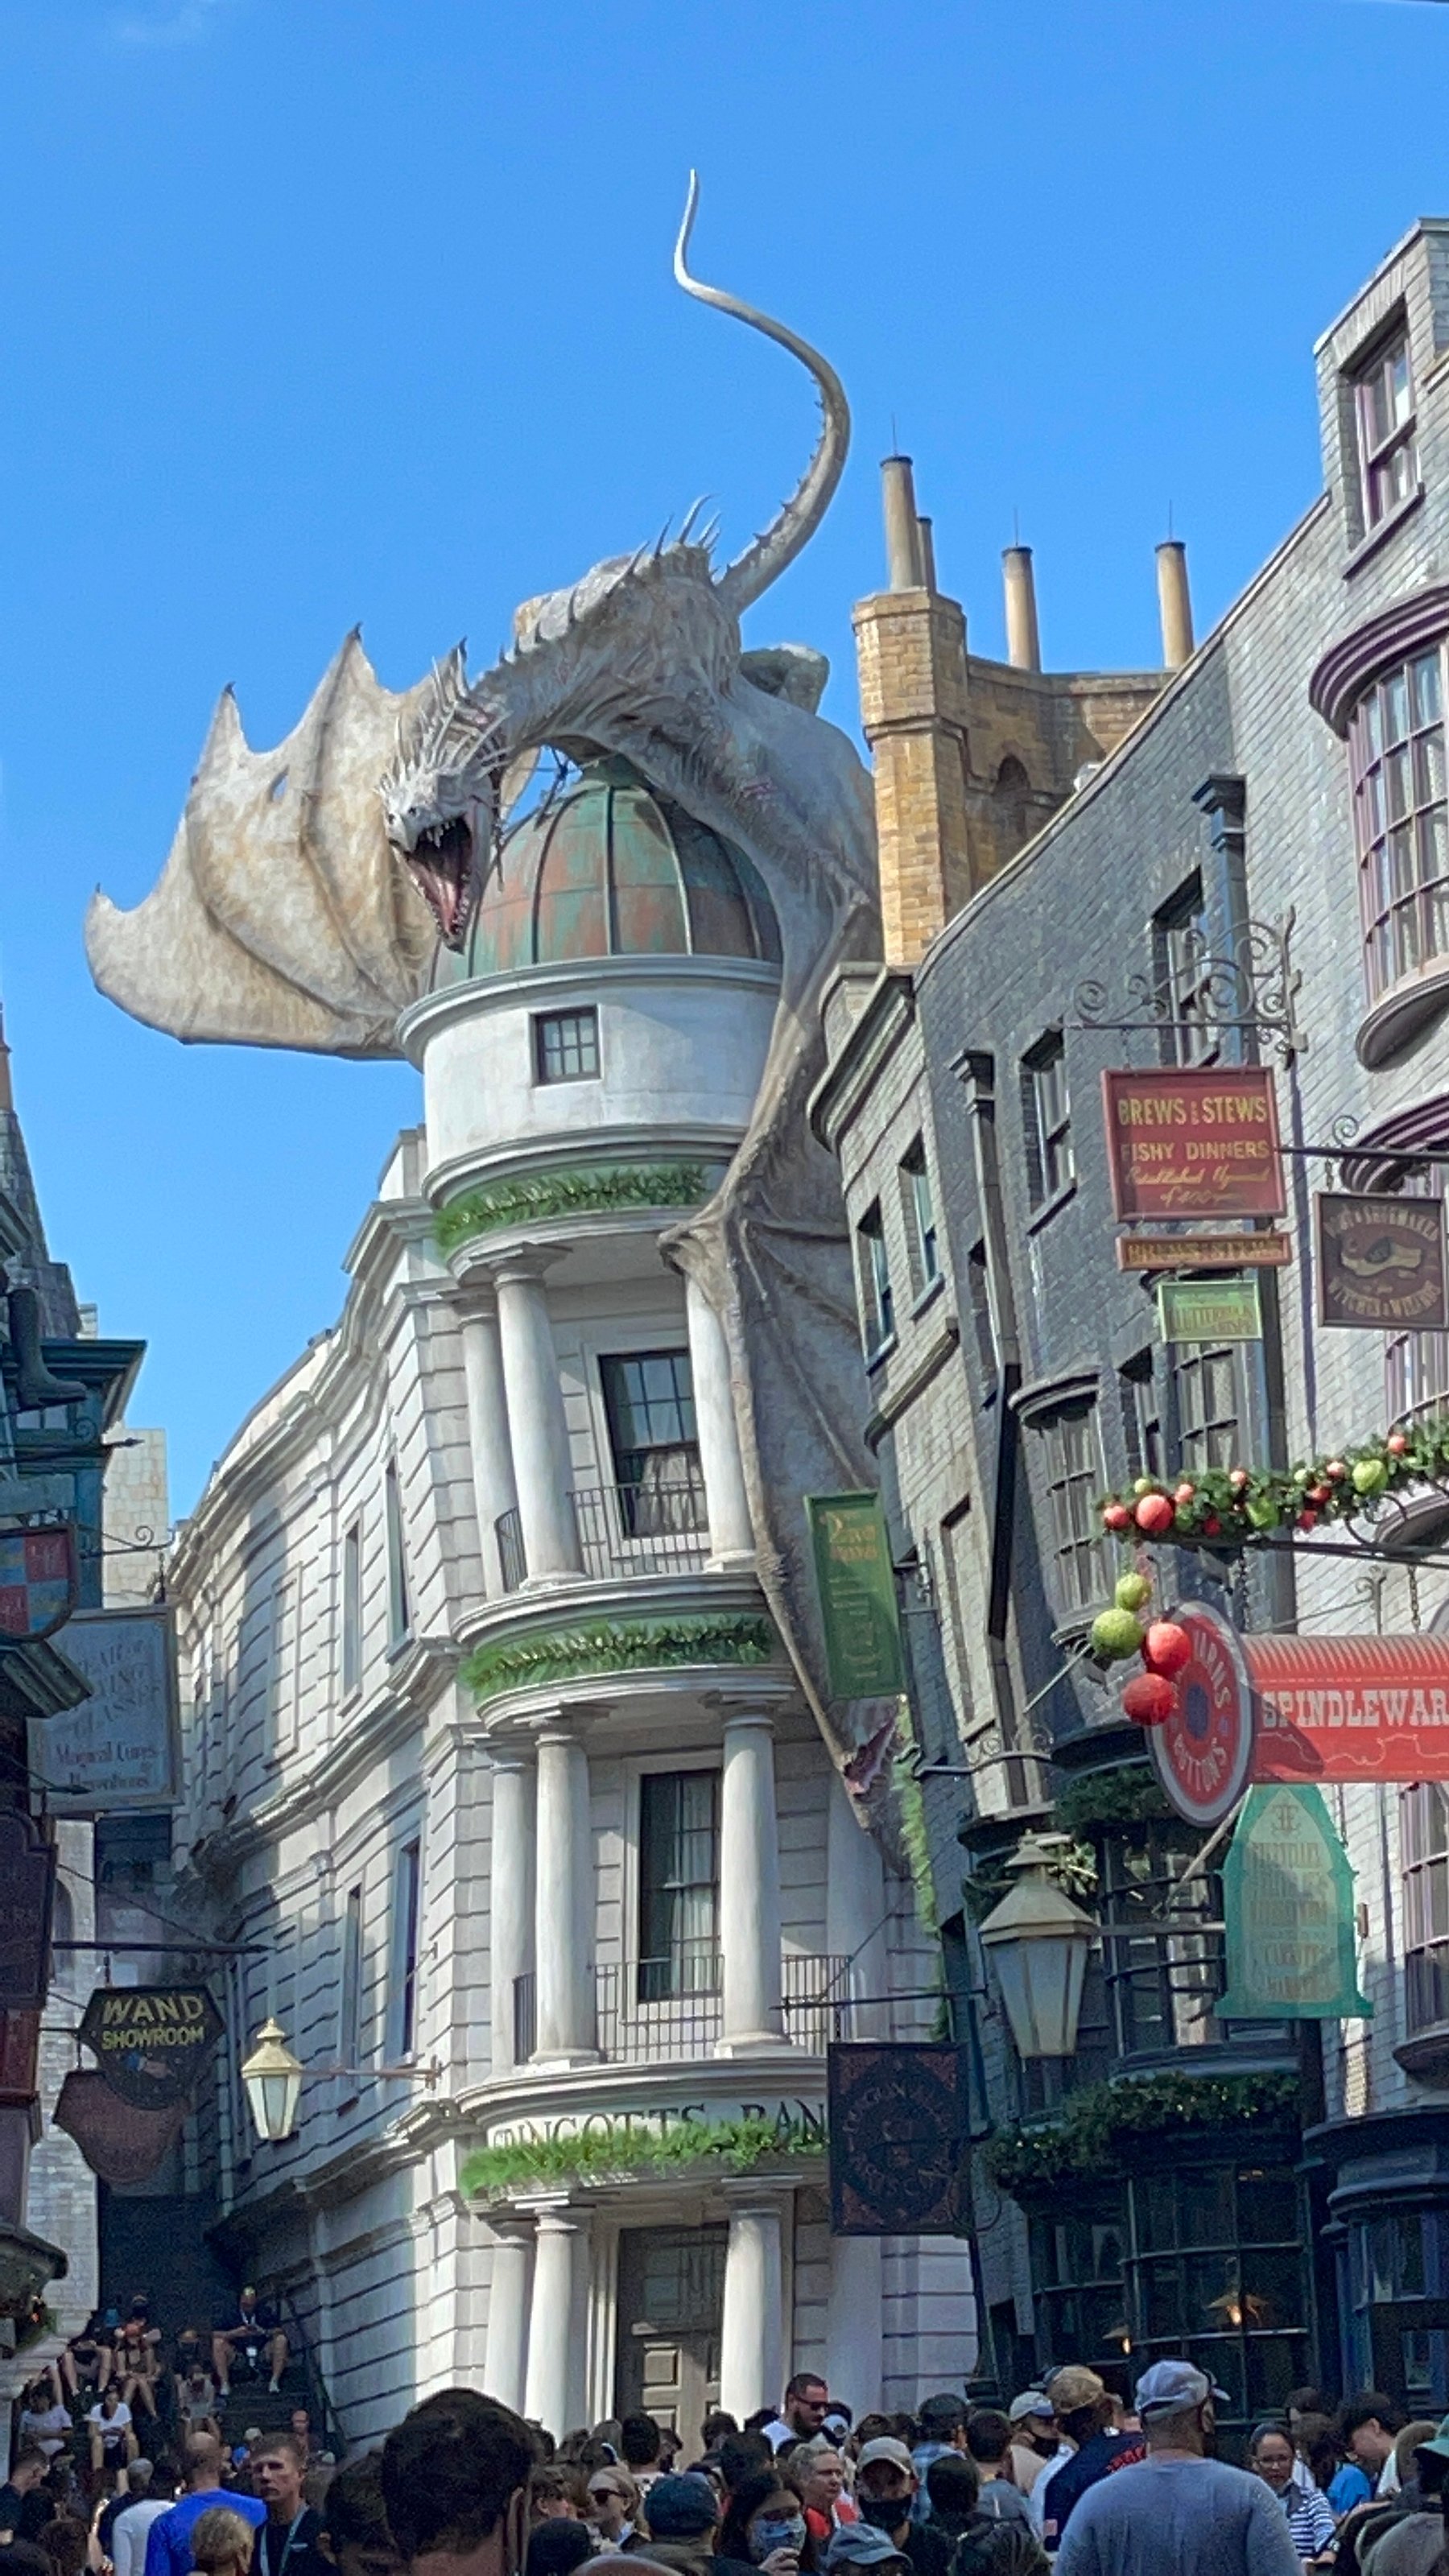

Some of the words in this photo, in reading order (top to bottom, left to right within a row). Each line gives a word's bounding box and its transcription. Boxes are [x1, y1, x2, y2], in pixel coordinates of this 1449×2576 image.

[1118, 1096, 1187, 1125] BREWS
[1201, 1096, 1268, 1124] STEWS
[1120, 1141, 1175, 1162] FISHY
[1185, 1139, 1269, 1160] DINNERS
[1261, 1689, 1449, 1728] SPINDLEWAR
[102, 1993, 204, 2025] WAND
[101, 2025, 204, 2051] SHOWROOM
